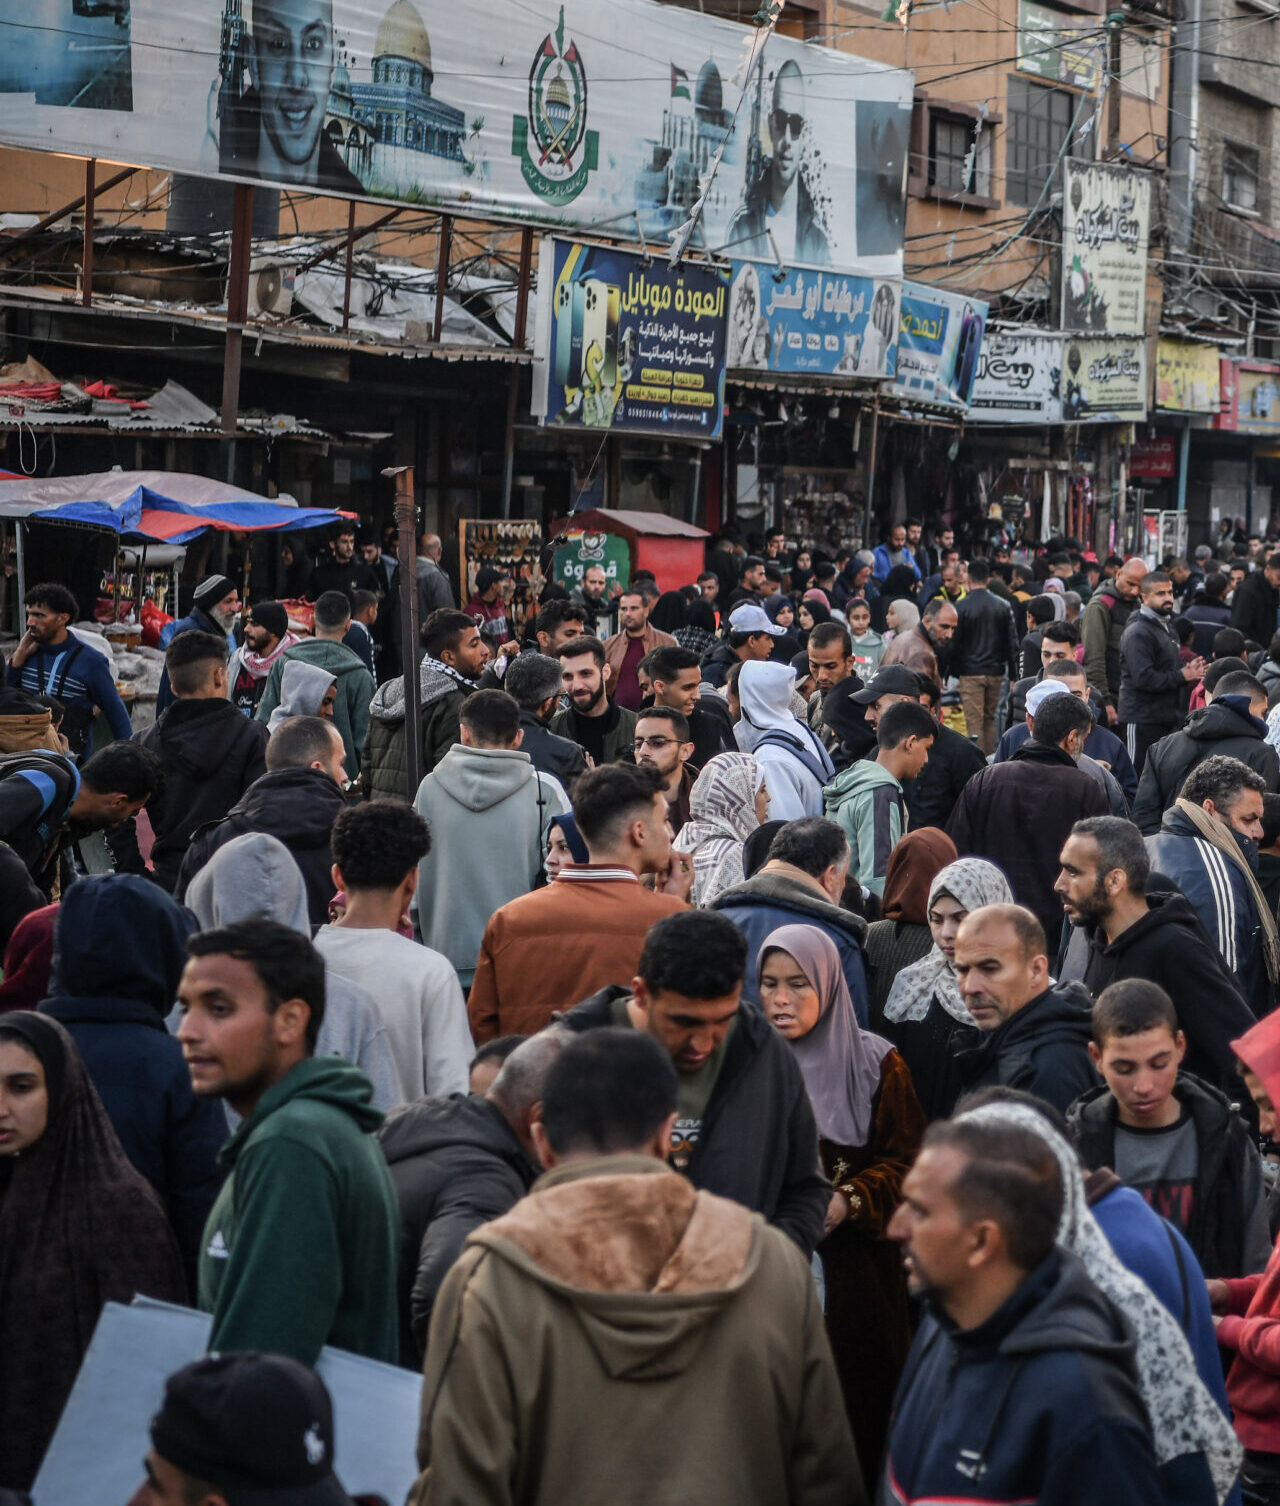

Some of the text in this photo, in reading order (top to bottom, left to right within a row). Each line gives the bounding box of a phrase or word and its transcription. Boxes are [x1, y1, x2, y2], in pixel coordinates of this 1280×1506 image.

[622, 272, 725, 322] العودة موبايل
[679, 328, 698, 345] جميع
[911, 307, 945, 340] أحمد
[987, 357, 1034, 390] بيت
[563, 559, 617, 581] قوة
